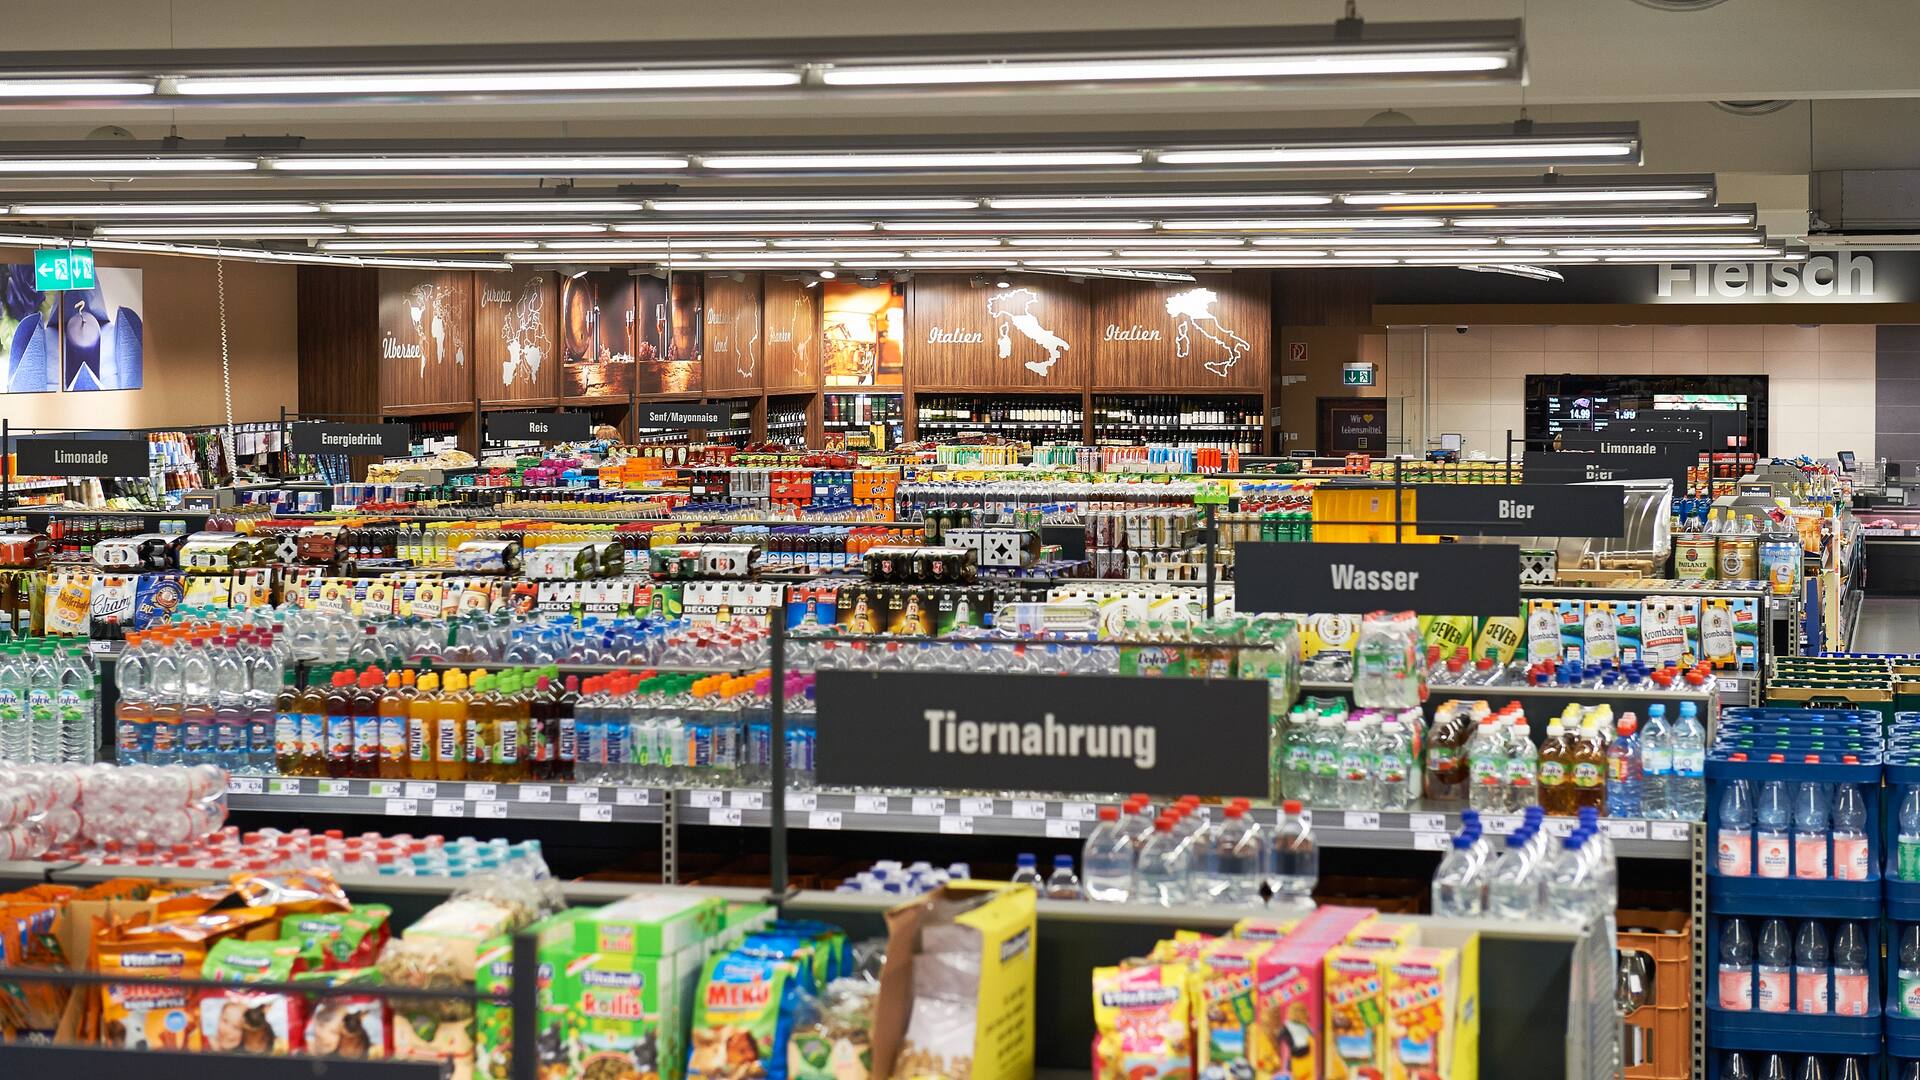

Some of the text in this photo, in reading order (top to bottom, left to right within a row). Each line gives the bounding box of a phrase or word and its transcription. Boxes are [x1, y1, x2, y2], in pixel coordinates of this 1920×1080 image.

[928, 326, 984, 344] Italien
[1104, 324, 1162, 342] Italien
[382, 331, 421, 359] Übersee
[649, 411, 718, 424] Senf/Mayonnaise
[1569, 408, 1591, 419] 14.99
[529, 422, 549, 433] Reis
[321, 432, 383, 448] Energiedrink
[55, 449, 109, 464] Limonade
[1601, 442, 1657, 455] Limonade
[1498, 499, 1535, 519] Bier
[1330, 563, 1420, 591] Wasser
[585, 603, 619, 612] BECK'S
[683, 605, 718, 614] BECK'S
[732, 606, 767, 615] BECK'S
[1431, 621, 1462, 646] JEVER
[1486, 623, 1518, 647] JEVER
[923, 709, 1157, 770] Tiernahrung
